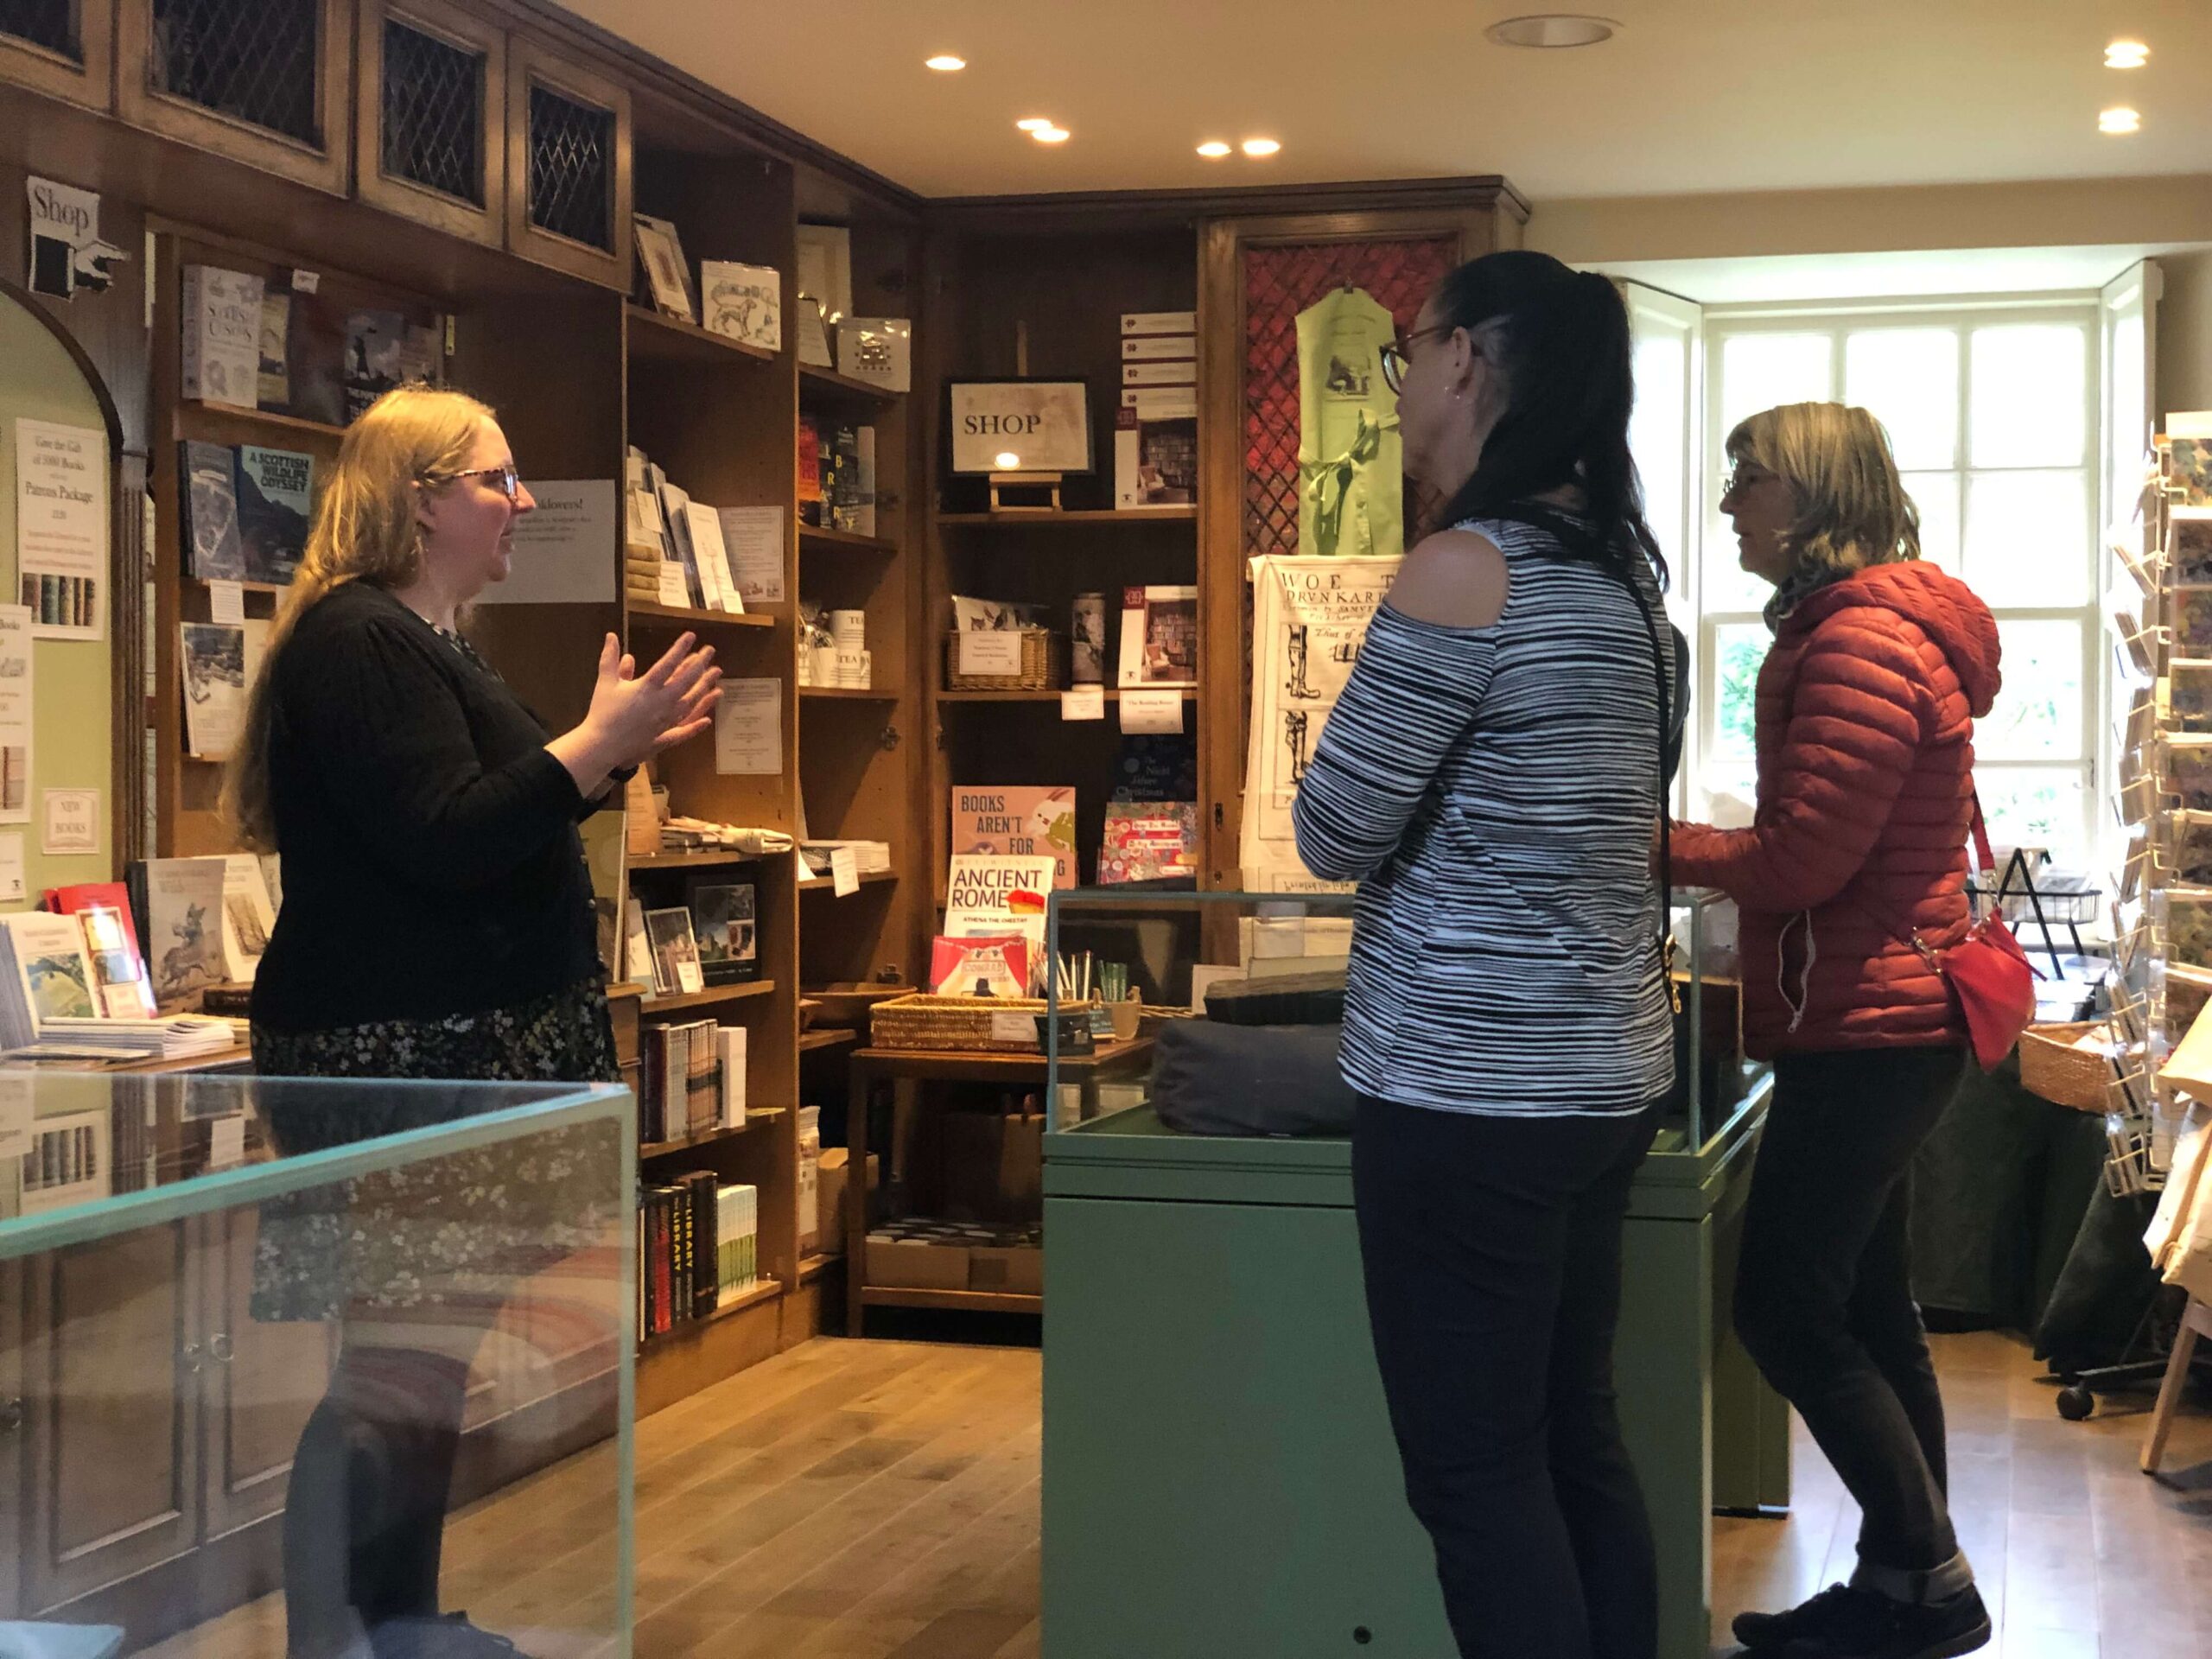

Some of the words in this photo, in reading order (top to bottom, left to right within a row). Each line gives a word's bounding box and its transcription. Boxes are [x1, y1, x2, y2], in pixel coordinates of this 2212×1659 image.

[34, 185, 89, 237] Shop
[964, 415, 1041, 435] SHOP
[250, 452, 257, 464] A
[258, 453, 309, 469] SCOTTISH
[263, 465, 308, 481] WILDLIFE
[25, 480, 57, 499] Patrons
[59, 485, 94, 505] Package
[261, 475, 307, 493] ODYSSEY
[1281, 573, 1341, 590] WOE
[60, 801, 82, 813] NEW
[962, 795, 1005, 812] BOOKS
[54, 822, 87, 834] BOOKS
[976, 817, 1023, 833] AREN'T
[1009, 837, 1034, 855] FOR
[954, 868, 1043, 888] ANCIENT
[952, 889, 1009, 908] ROME
[673, 1211, 682, 1271] LIBRARY
